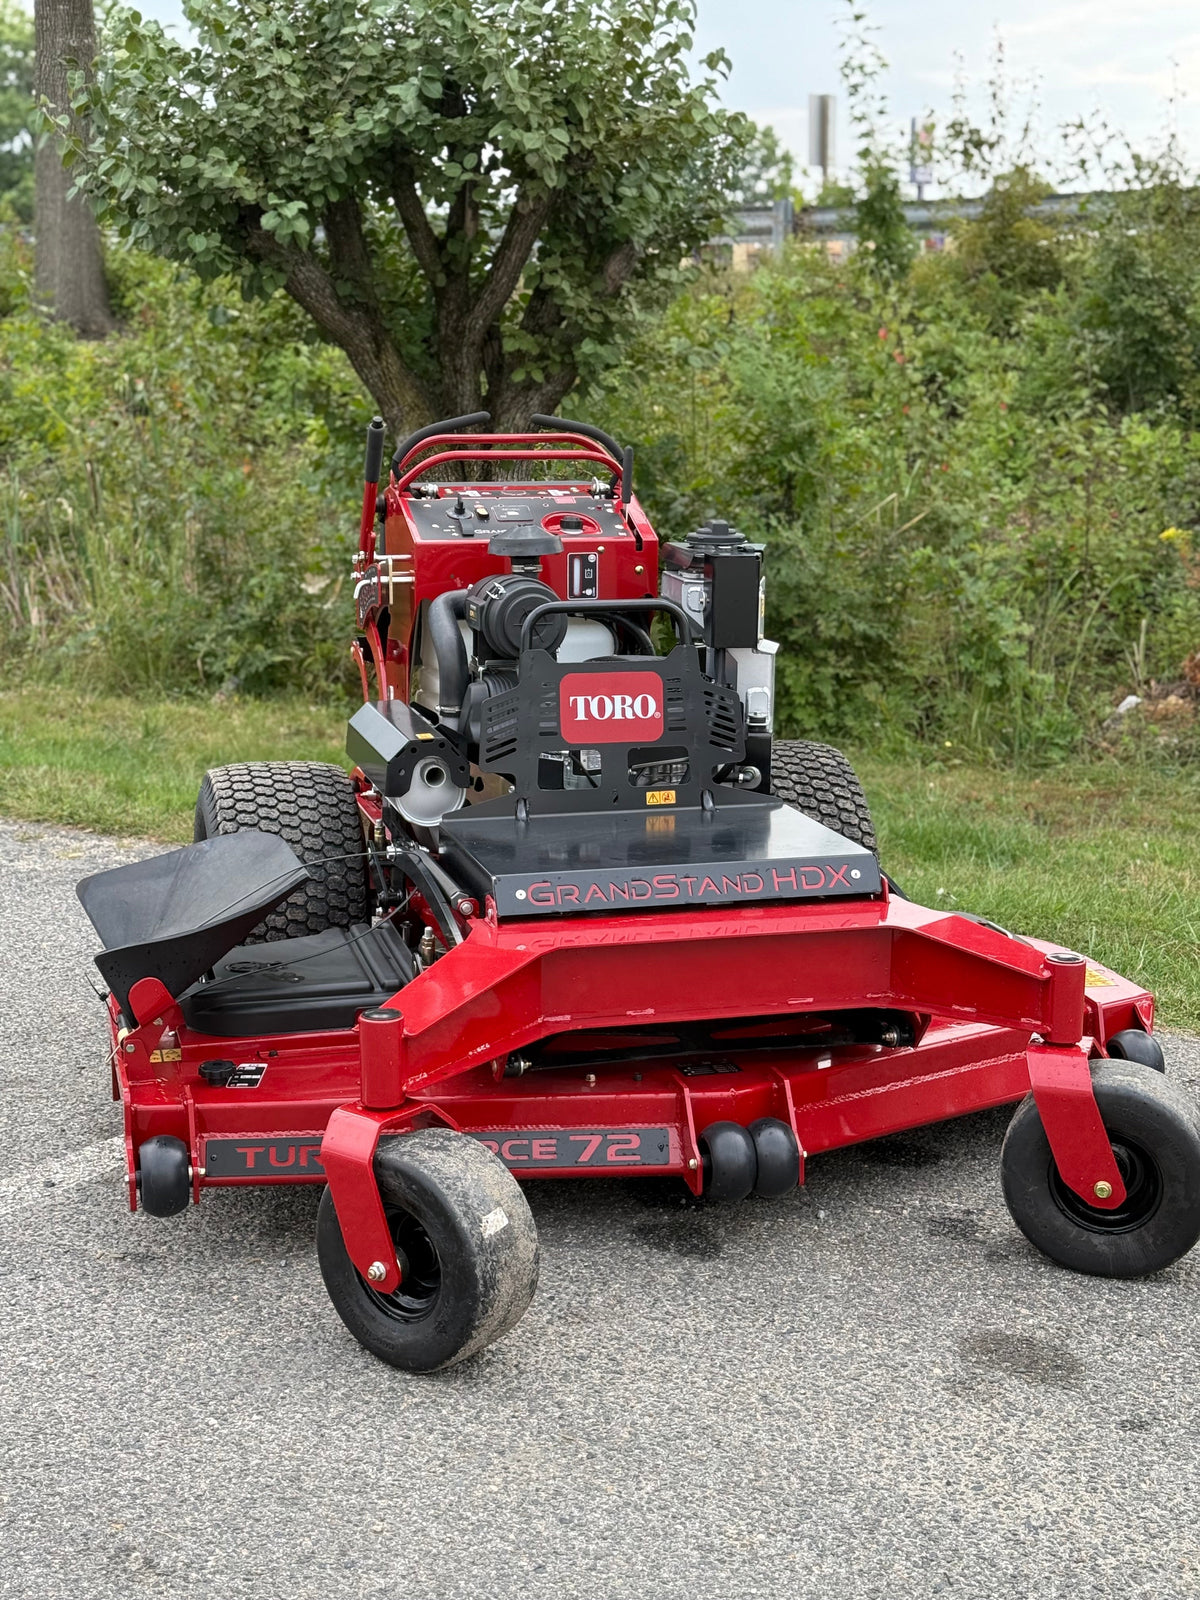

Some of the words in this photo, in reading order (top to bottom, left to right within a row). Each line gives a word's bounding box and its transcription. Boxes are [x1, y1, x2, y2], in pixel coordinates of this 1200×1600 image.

[772, 864, 852, 891] HDX
[235, 1145, 325, 1168] TUR
[569, 1134, 641, 1162] 72
